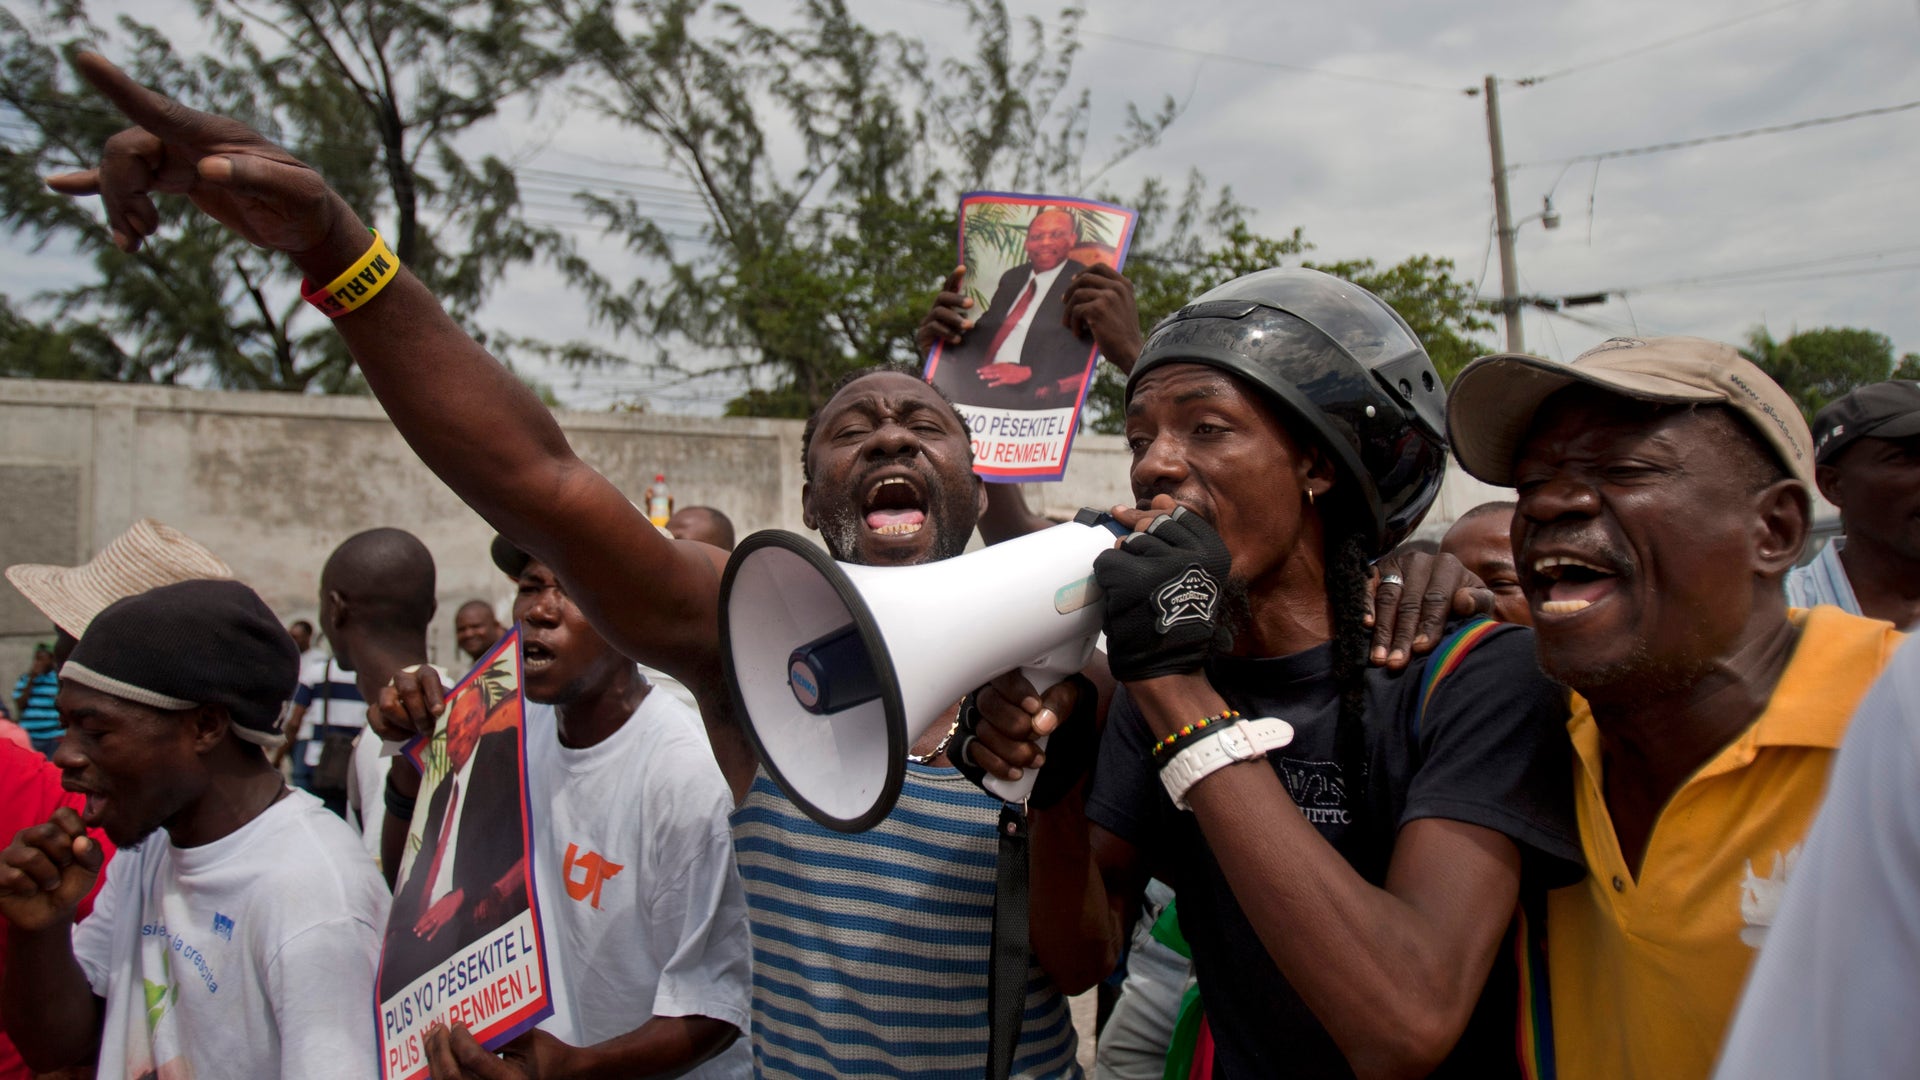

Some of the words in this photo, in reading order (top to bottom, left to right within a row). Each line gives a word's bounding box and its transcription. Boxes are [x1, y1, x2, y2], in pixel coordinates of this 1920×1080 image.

[990, 411, 1058, 438] PÈSEKITE
[1058, 415, 1065, 435] L
[995, 442, 1049, 463] RENMEN
[1051, 441, 1058, 461] L
[172, 933, 184, 951] la
[183, 945, 219, 994] crescita
[385, 997, 414, 1040] PLIS
[414, 982, 434, 1018] YO
[438, 932, 516, 1003] PÈSEKITE
[520, 925, 532, 954] L
[389, 1034, 420, 1078] PLIS
[449, 970, 524, 1031] RENMEN
[525, 964, 537, 994] L
